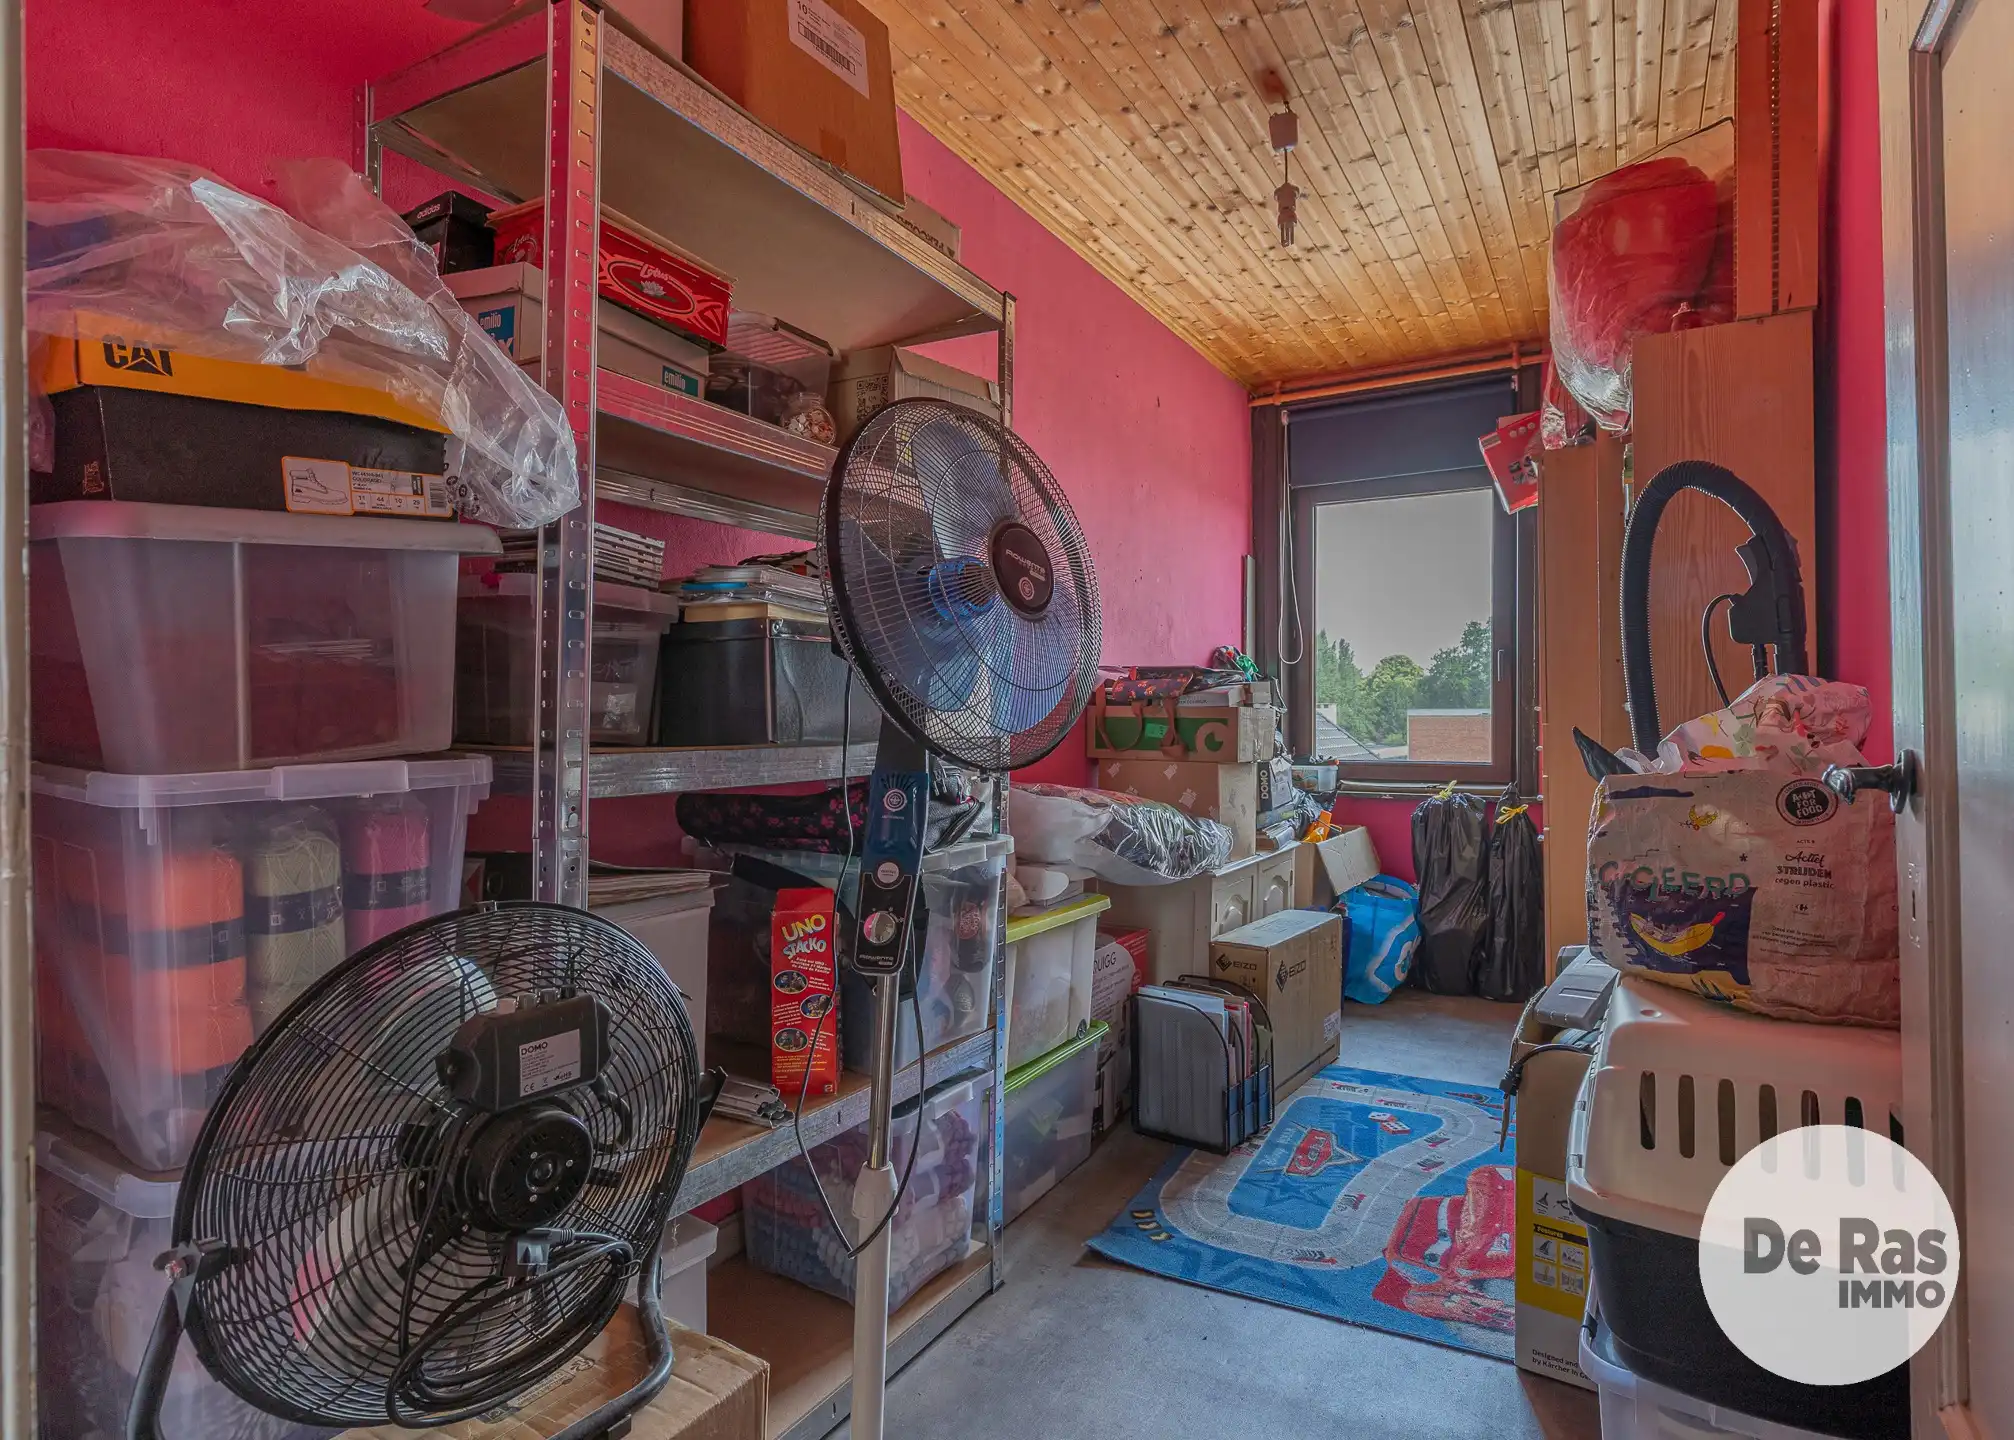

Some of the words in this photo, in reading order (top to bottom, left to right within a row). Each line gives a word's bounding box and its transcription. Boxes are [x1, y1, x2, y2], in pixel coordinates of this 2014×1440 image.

[416, 204, 441, 219] adidas
[640, 263, 670, 281] Lotus
[102, 333, 178, 377] CAT
[664, 371, 686, 390] emilio
[1260, 769, 1269, 800] DOMO
[1796, 799, 1817, 809] FOR
[1803, 879, 1836, 889] plastic
[781, 914, 827, 942] UNO
[783, 937, 828, 960] STACKO
[1233, 961, 1258, 971] EIZO
[1289, 959, 1307, 978] EIZO
[521, 1041, 549, 1056] DOMO
[1532, 1348, 1564, 1364] Designed
[1532, 1357, 1541, 1366] by
